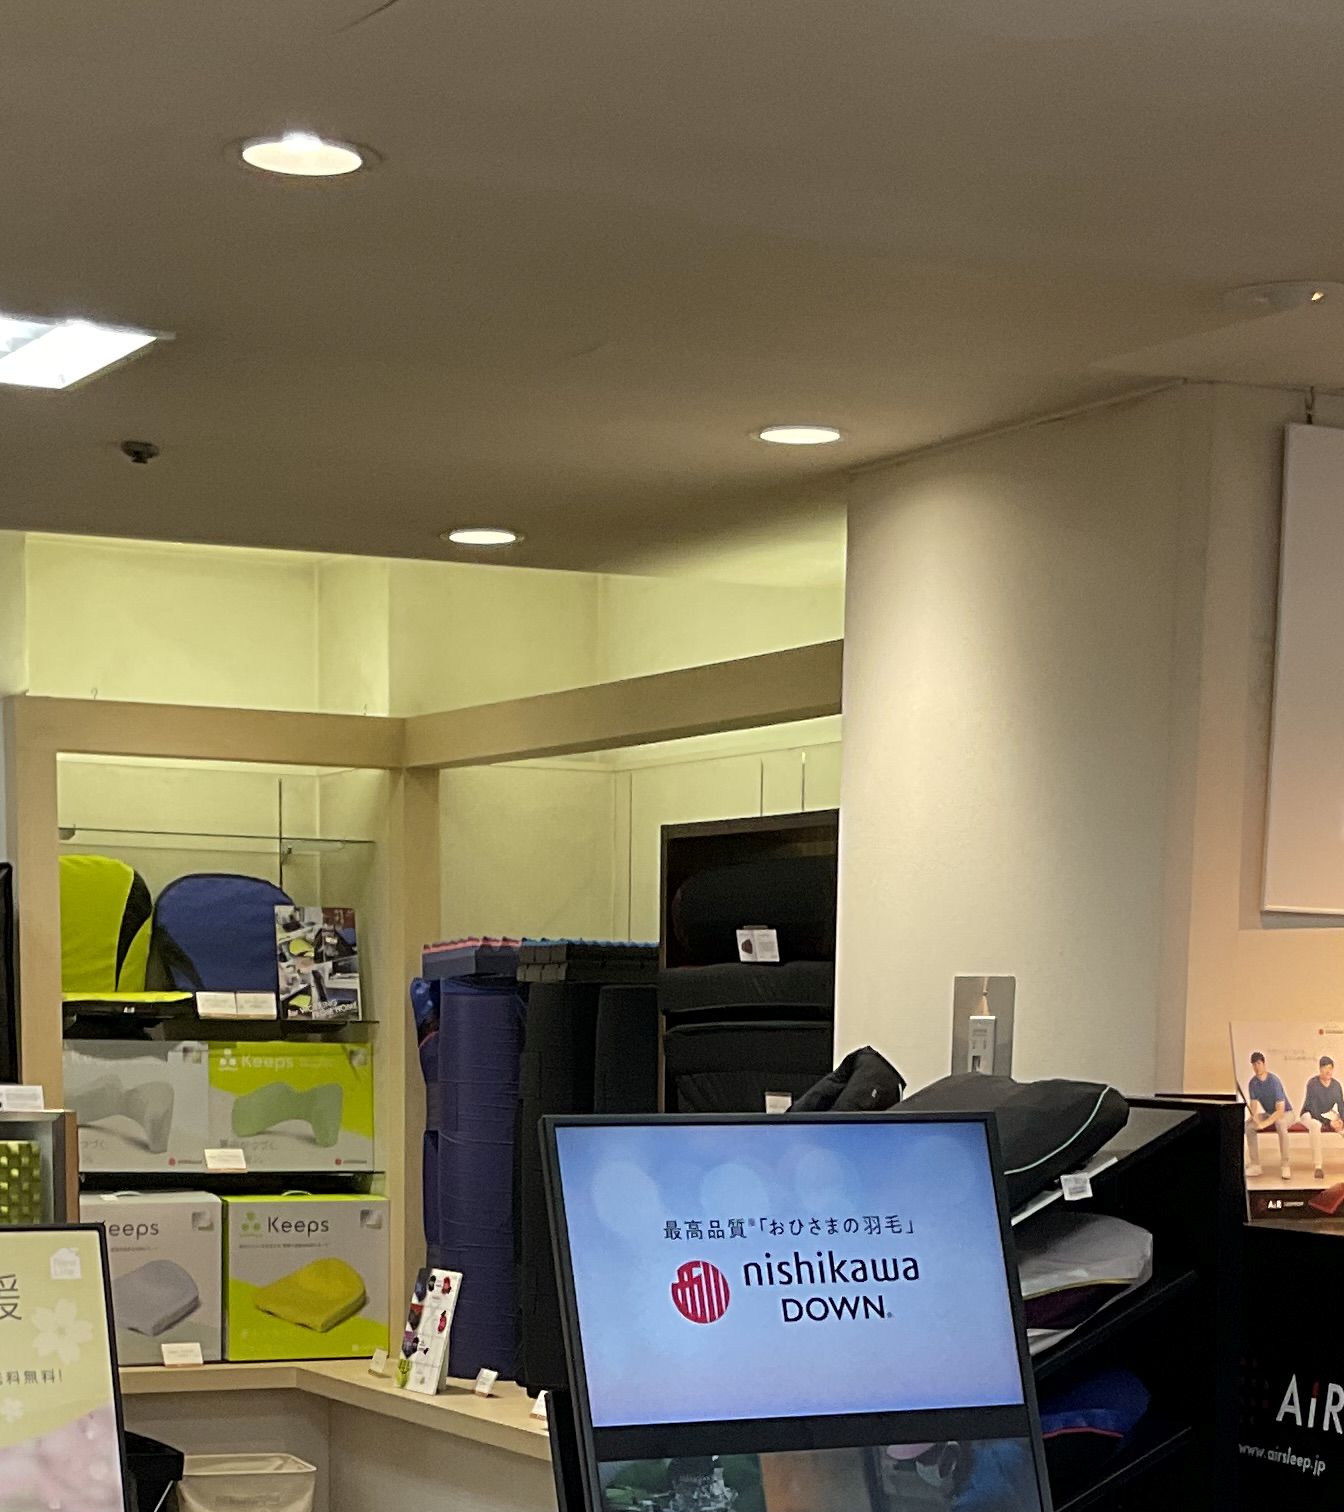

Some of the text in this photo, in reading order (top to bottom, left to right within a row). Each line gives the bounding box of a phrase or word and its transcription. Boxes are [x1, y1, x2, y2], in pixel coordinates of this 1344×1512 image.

[108, 1221, 160, 1240] eeps
[267, 1215, 330, 1238] Keeps
[742, 1250, 921, 1287] nishikawa
[1238, 1440, 1327, 1477] www.airsleep.jp
